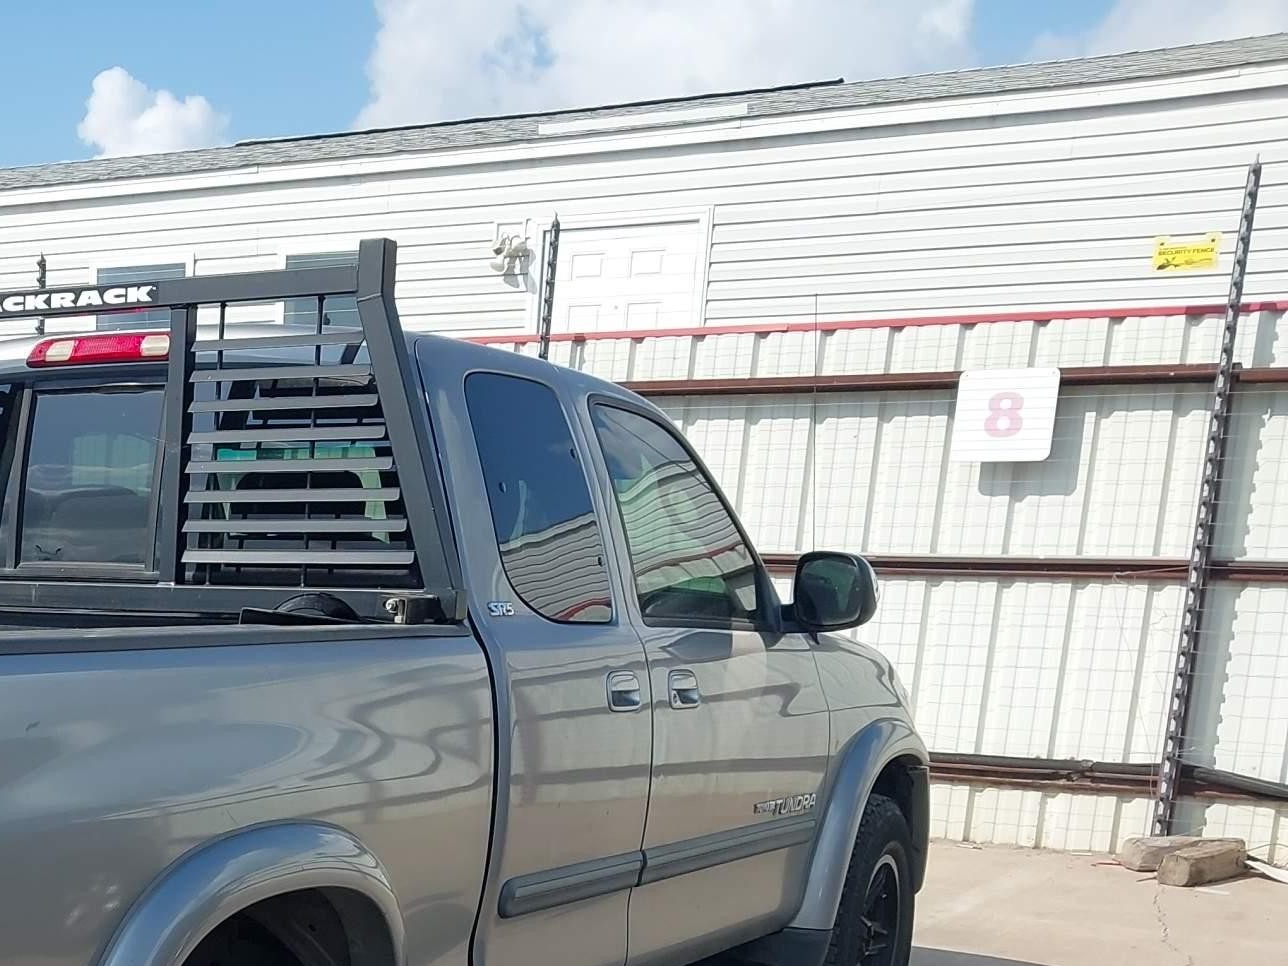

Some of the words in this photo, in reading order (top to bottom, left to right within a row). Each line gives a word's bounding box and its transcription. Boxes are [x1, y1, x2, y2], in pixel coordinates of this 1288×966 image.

[984, 391, 1024, 438] 8
[487, 602, 515, 616] SR5
[775, 793, 816, 815] TUNDRA
